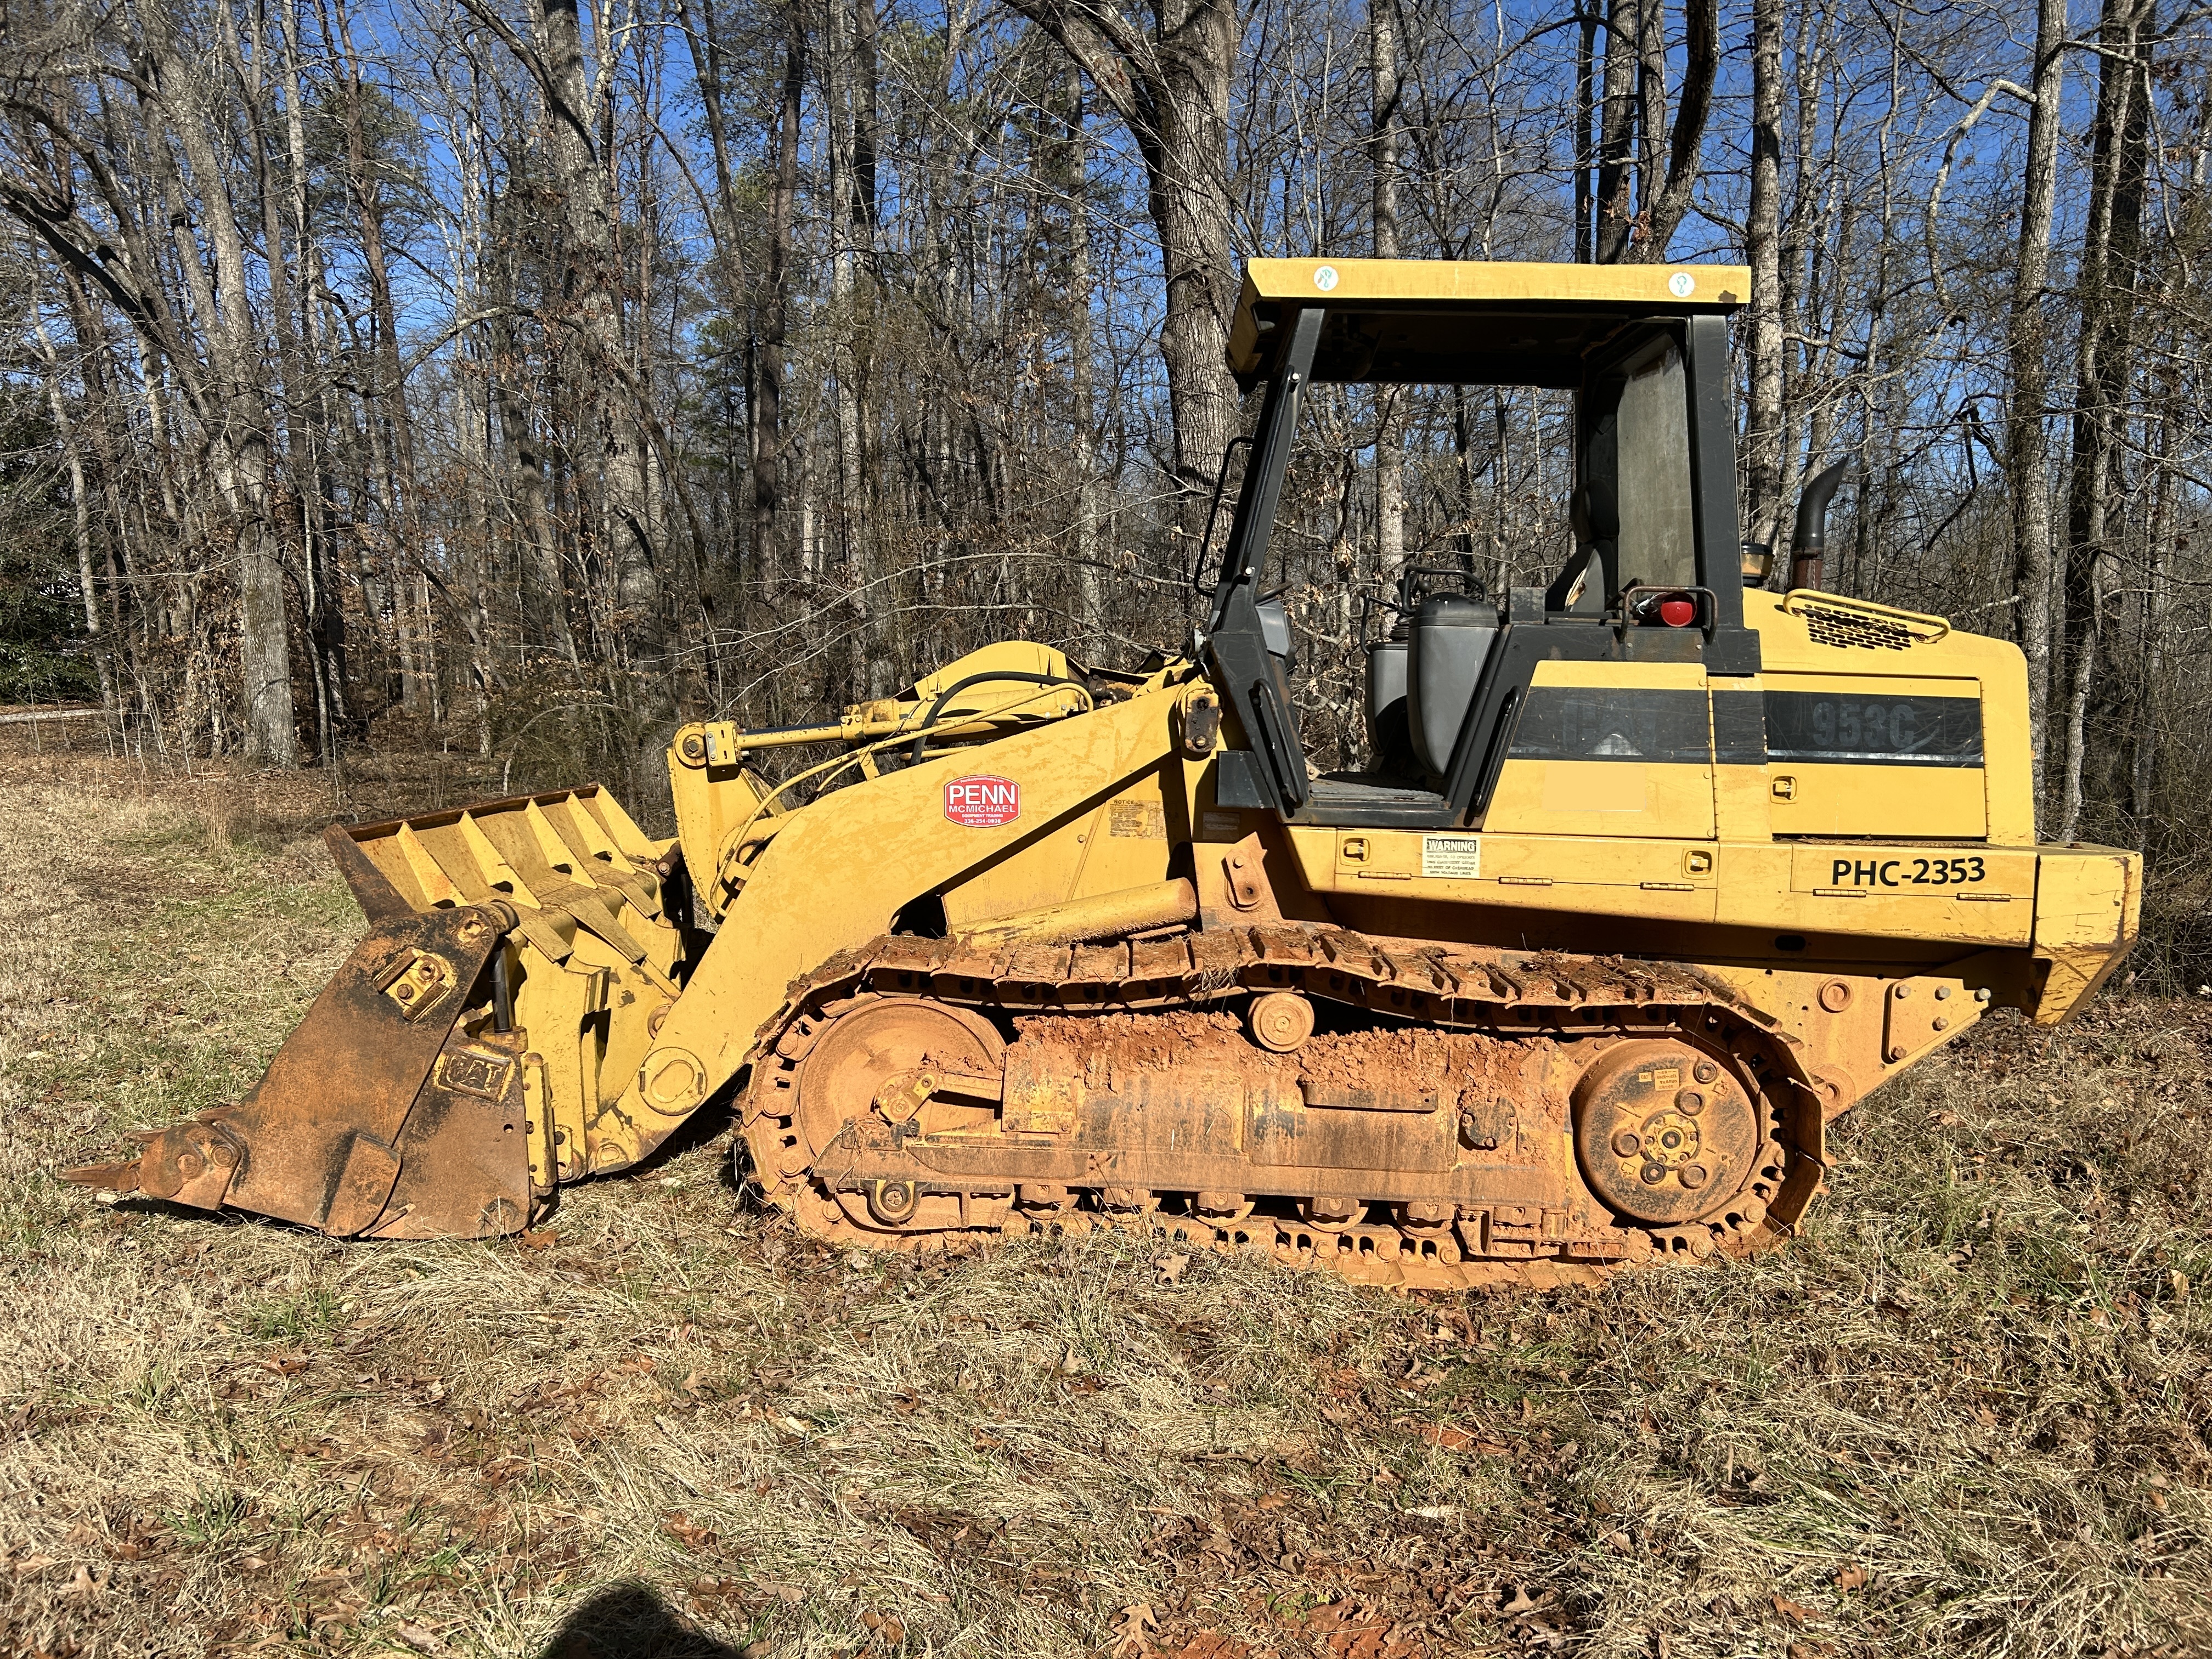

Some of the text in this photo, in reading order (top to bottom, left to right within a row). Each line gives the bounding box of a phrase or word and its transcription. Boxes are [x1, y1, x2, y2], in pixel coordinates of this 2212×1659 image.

[1812, 702, 1915, 748] 953C
[949, 785, 1015, 805] PENN
[949, 805, 1016, 813] MCMICHAEL
[1427, 839, 1476, 852] WARNING
[1832, 856, 1985, 887] PHC-2353
[445, 1054, 503, 1093] CAT
